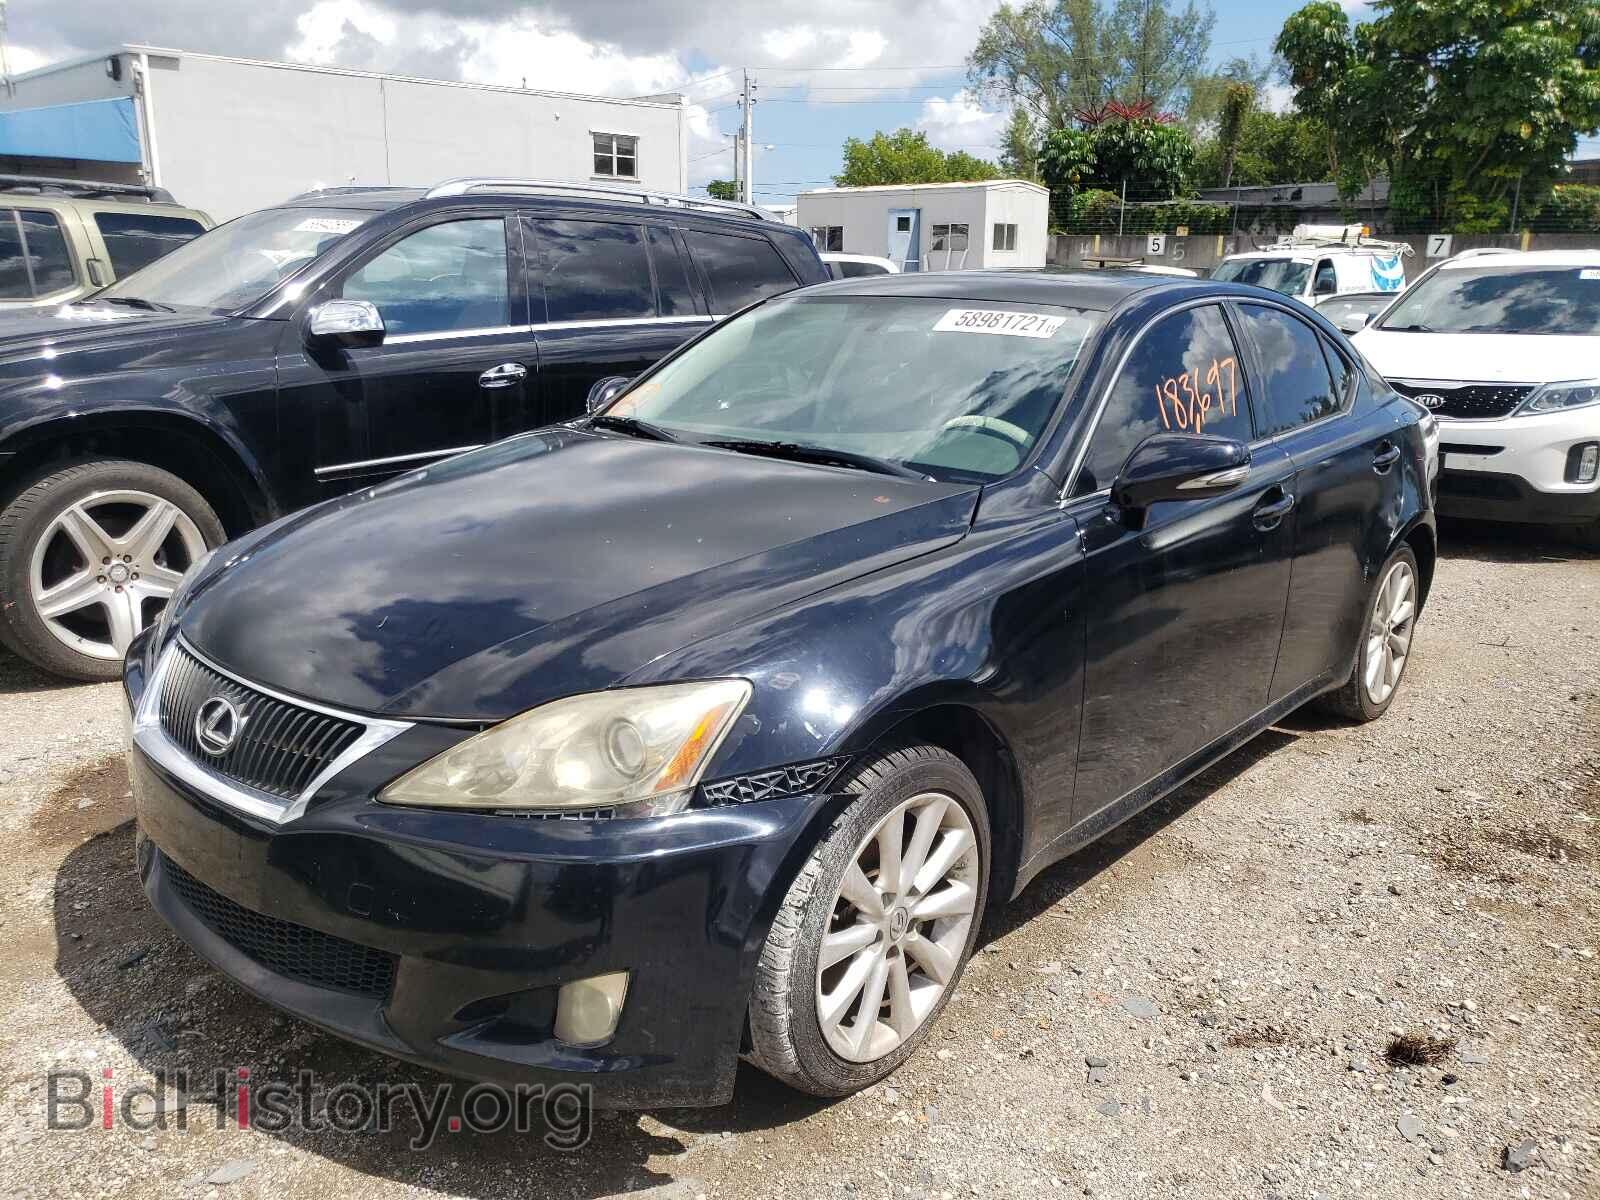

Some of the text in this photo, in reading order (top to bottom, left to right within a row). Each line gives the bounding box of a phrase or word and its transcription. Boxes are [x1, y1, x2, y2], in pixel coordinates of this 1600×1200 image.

[1152, 237, 1160, 252] 5
[1434, 238, 1445, 254] 7
[954, 311, 1049, 332] 58981721
[1417, 396, 1438, 406] KIA
